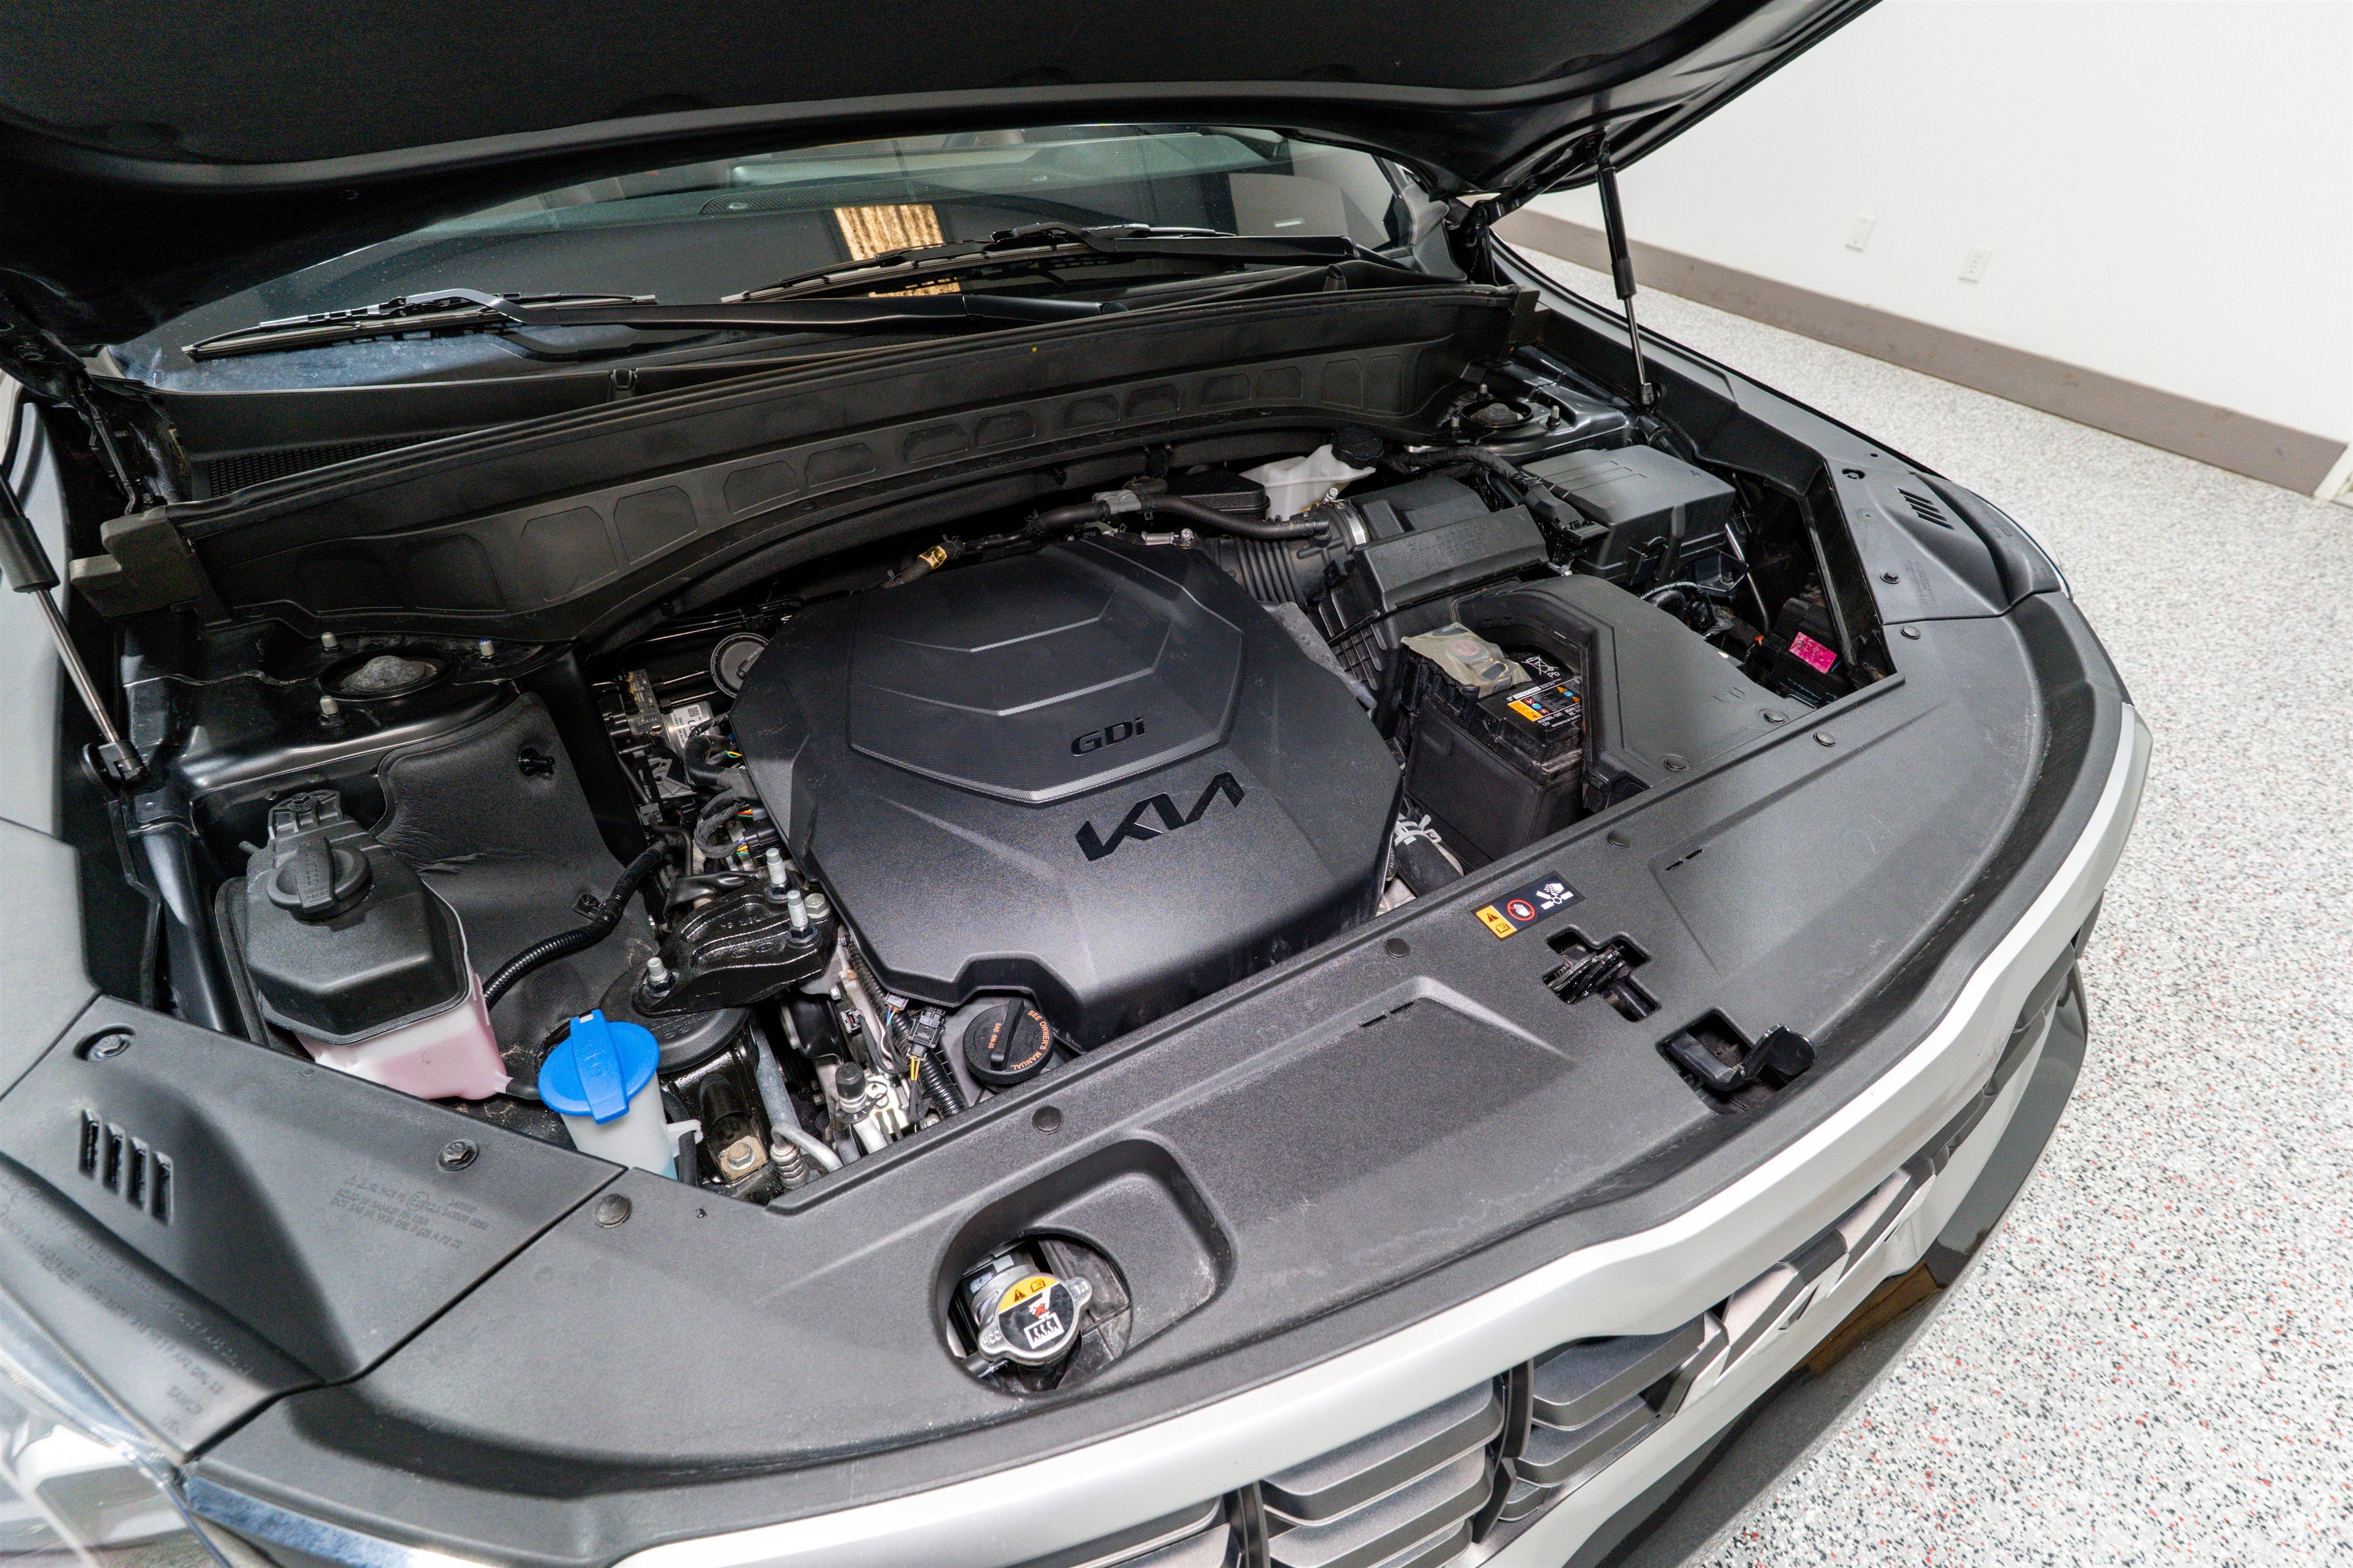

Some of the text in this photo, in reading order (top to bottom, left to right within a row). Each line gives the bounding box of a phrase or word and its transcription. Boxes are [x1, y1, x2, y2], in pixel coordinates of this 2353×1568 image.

[1070, 716, 1145, 756] GDi
[1075, 770, 1245, 862] KIA
[988, 1023, 1001, 1049] SAE 5W-30
[1010, 1010, 1050, 1071] SEE OWNER'S MANUAL
[982, 1330, 1002, 1347] HCC
